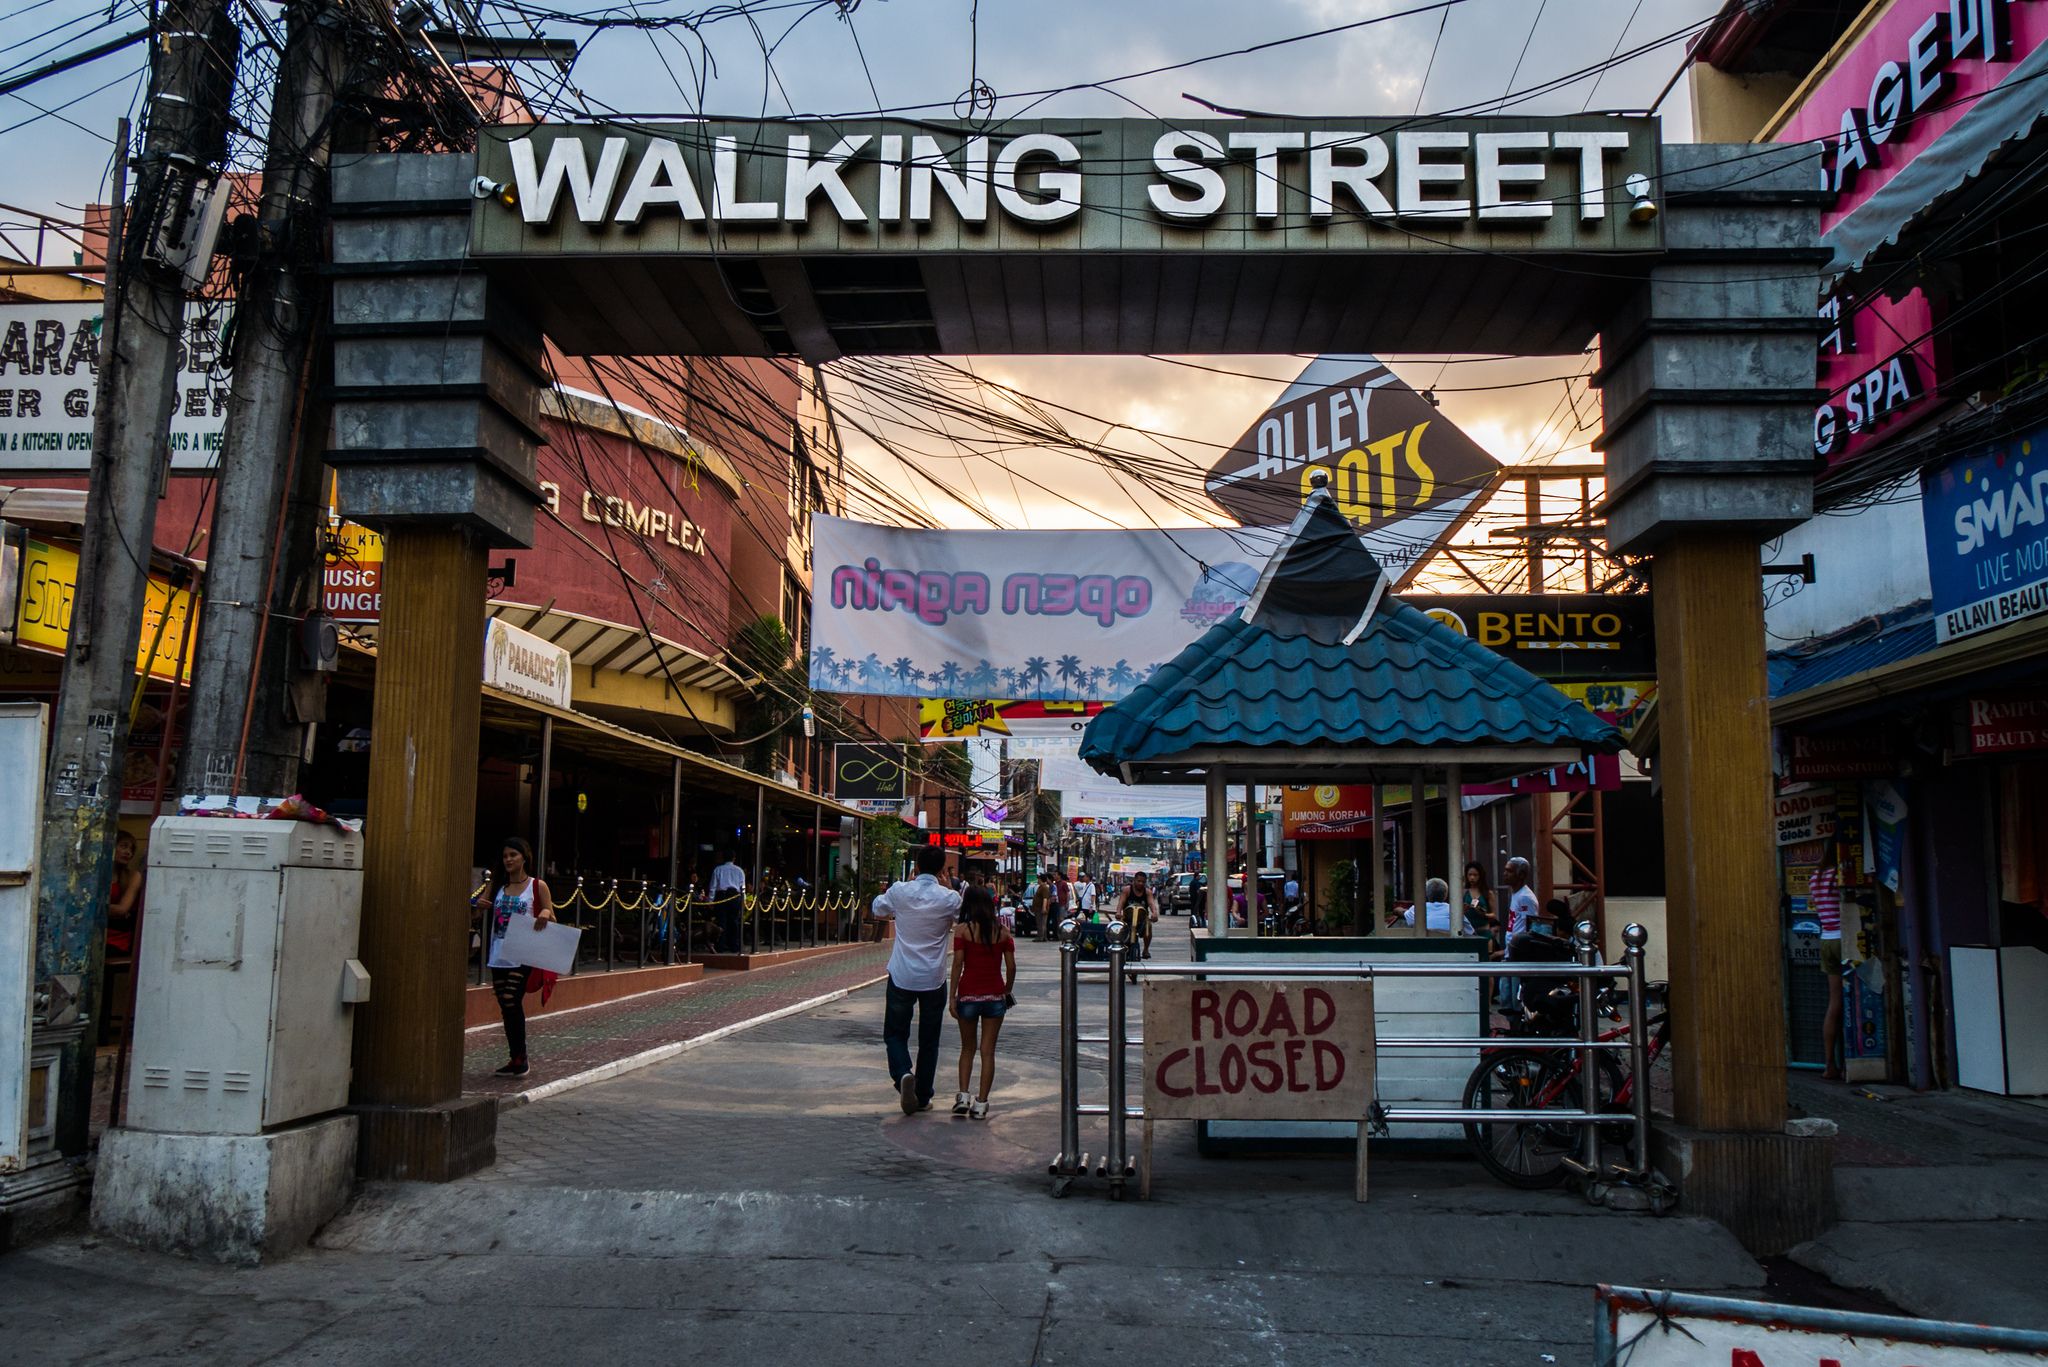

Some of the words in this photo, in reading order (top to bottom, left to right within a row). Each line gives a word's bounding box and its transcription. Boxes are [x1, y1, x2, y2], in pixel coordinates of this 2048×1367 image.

[1820, 12, 1942, 193] AGE
[507, 132, 1084, 225] WALKING
[1147, 130, 1630, 221] STREET
[1846, 356, 1910, 434] SPA
[22, 431, 63, 452] KITCHEN
[193, 432, 199, 452] A
[204, 432, 225, 452] WEE
[1255, 372, 1399, 480] ALLEY
[582, 489, 707, 557] COMPLEX
[323, 569, 377, 587] USiC
[1976, 551, 2012, 591] LIVE
[1478, 611, 1622, 647] BENTO
[1946, 600, 1997, 637] ELLAVI
[1527, 641, 1612, 649] BAR
[507, 641, 556, 687] PARADISE
[1975, 730, 2036, 748] BEAUTY
[1289, 810, 1325, 821] JUMONG
[1773, 797, 1810, 817] LOAD
[1777, 815, 1812, 831] SMART
[1780, 829, 1811, 842] Globe
[1191, 987, 1336, 1041] ROAD
[1155, 1039, 1346, 1098] CLOSED
